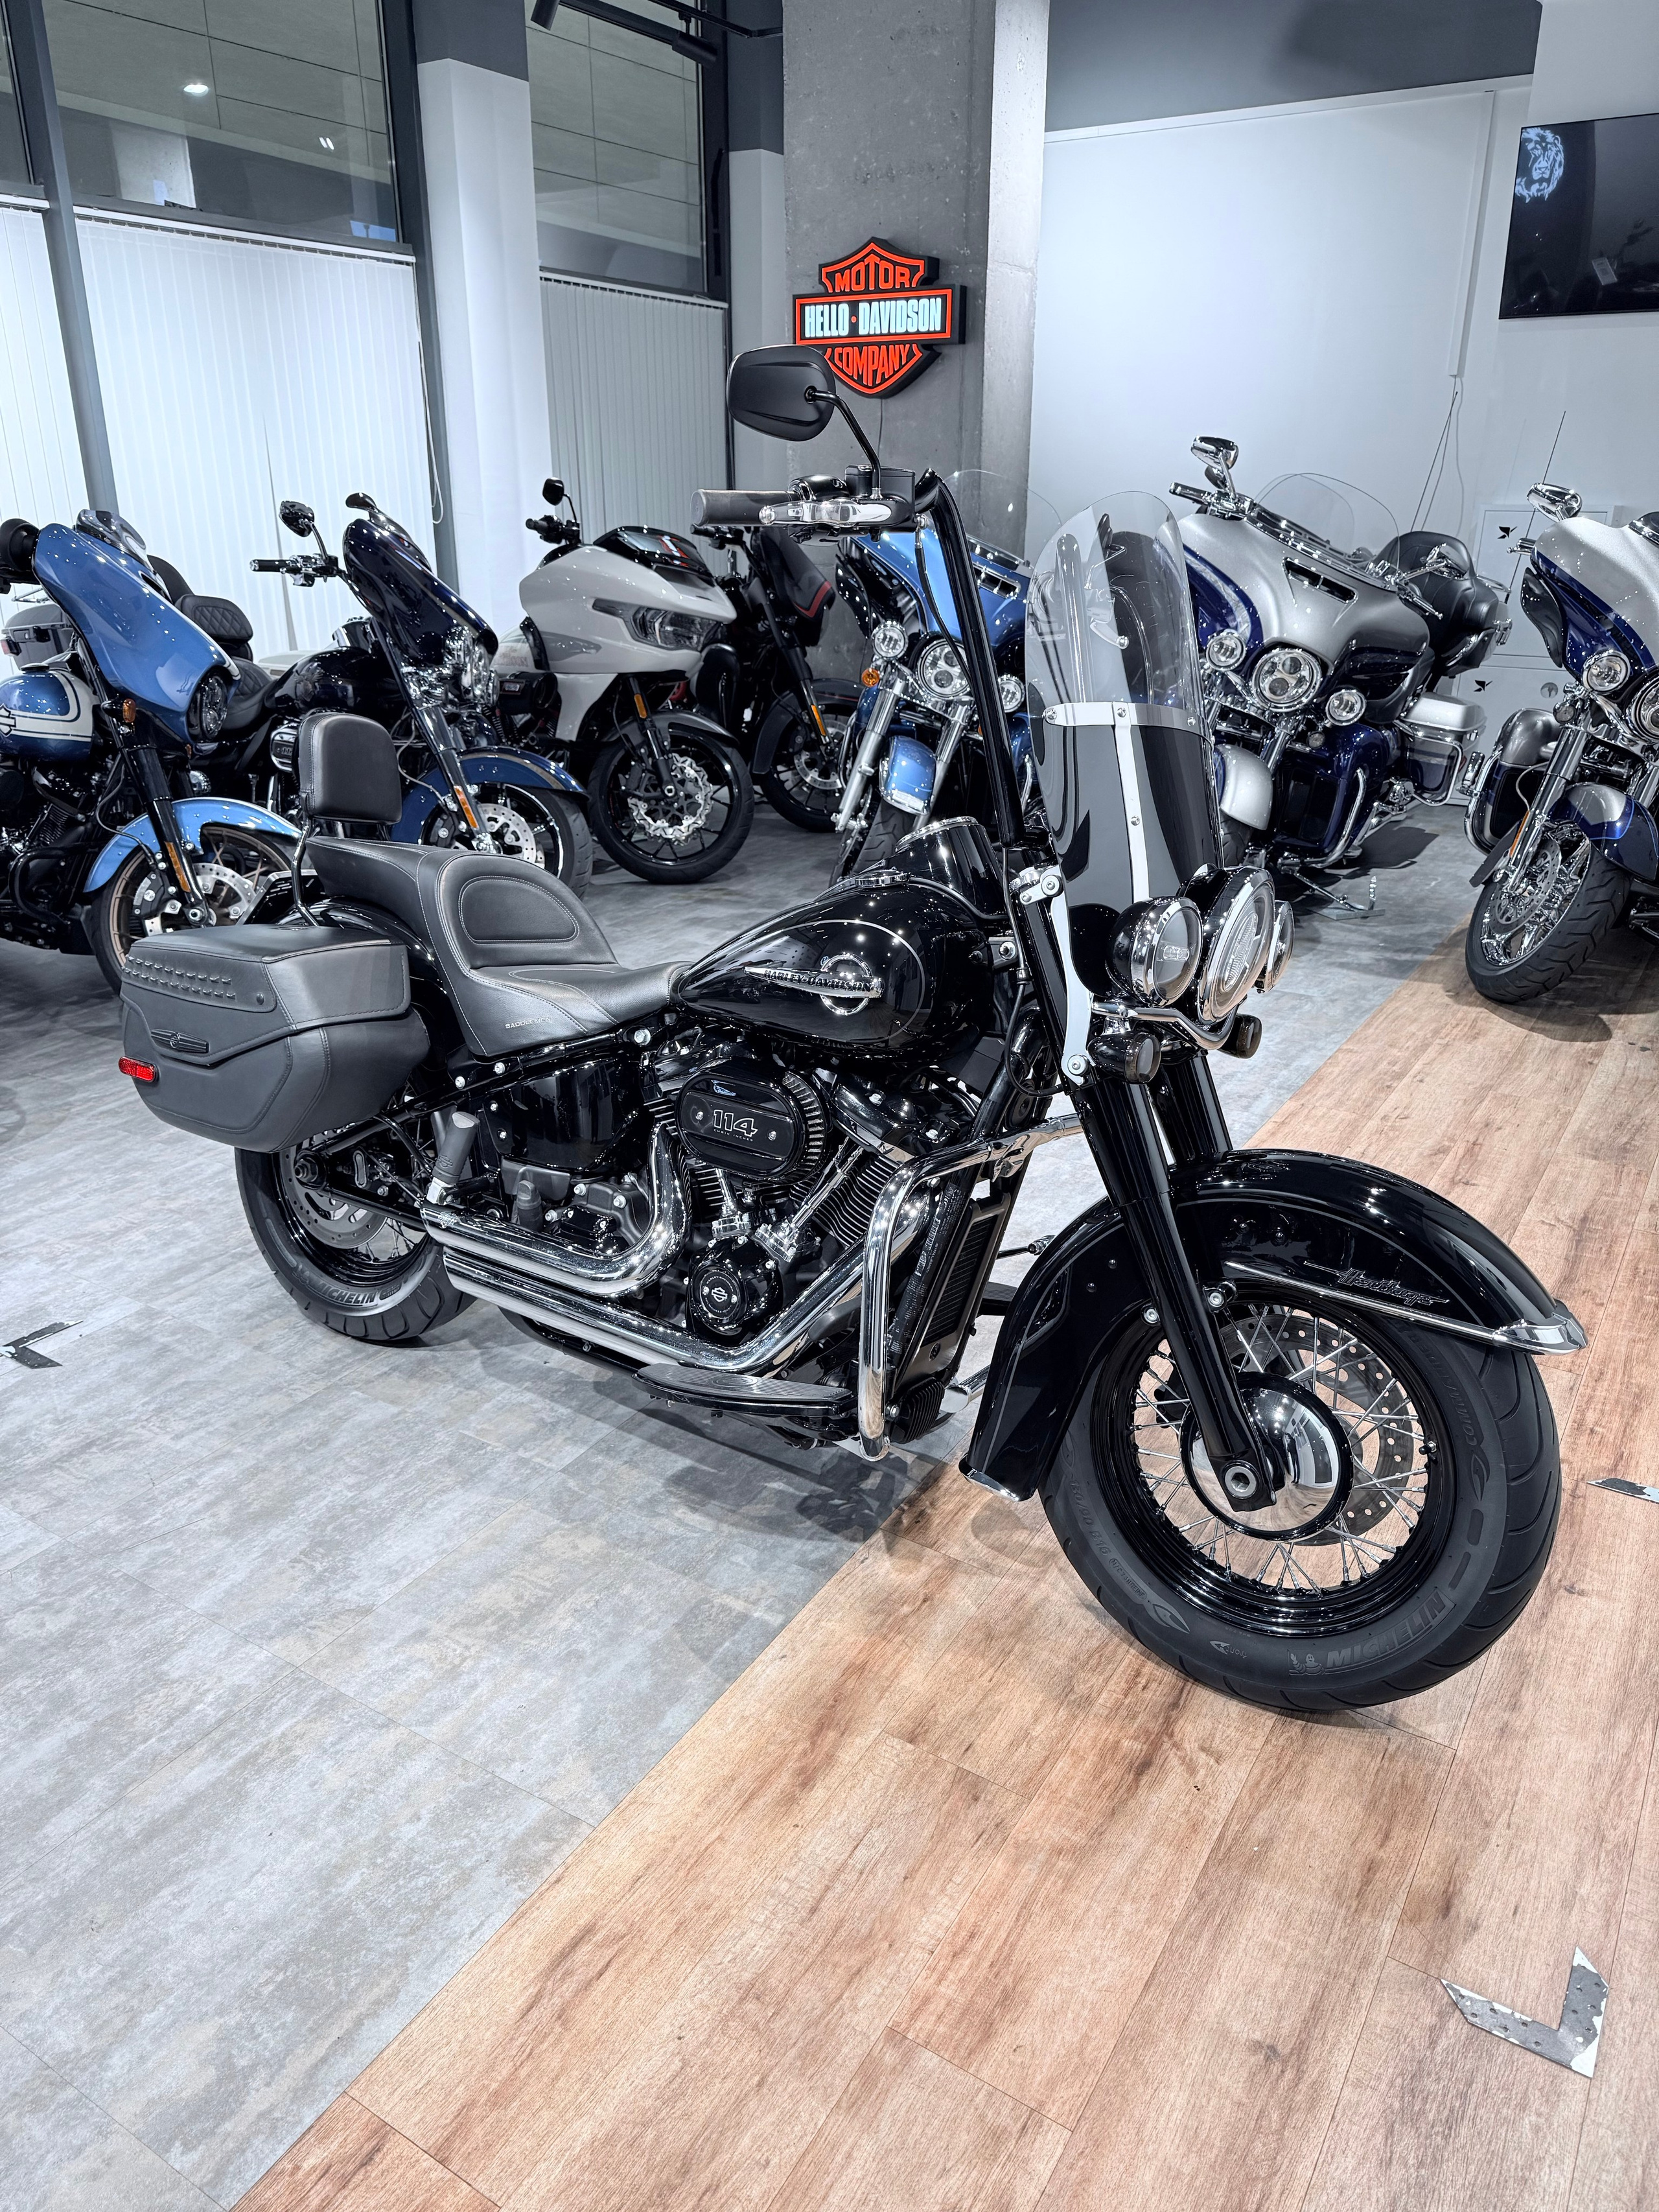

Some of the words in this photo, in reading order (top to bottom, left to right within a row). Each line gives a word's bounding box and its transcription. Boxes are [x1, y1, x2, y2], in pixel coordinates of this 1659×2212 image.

[835, 253, 911, 292] MOTOR
[804, 303, 850, 338] HELLO
[858, 297, 942, 335] DAVIDSON
[833, 343, 911, 387] COMPANY
[505, 1017, 551, 1029] SADDLEMEN
[713, 1109, 758, 1137] 114
[733, 1134, 754, 1142] INCHES
[317, 1281, 377, 1305] MICHELIN
[1328, 1592, 1446, 1668] MICHELIN
